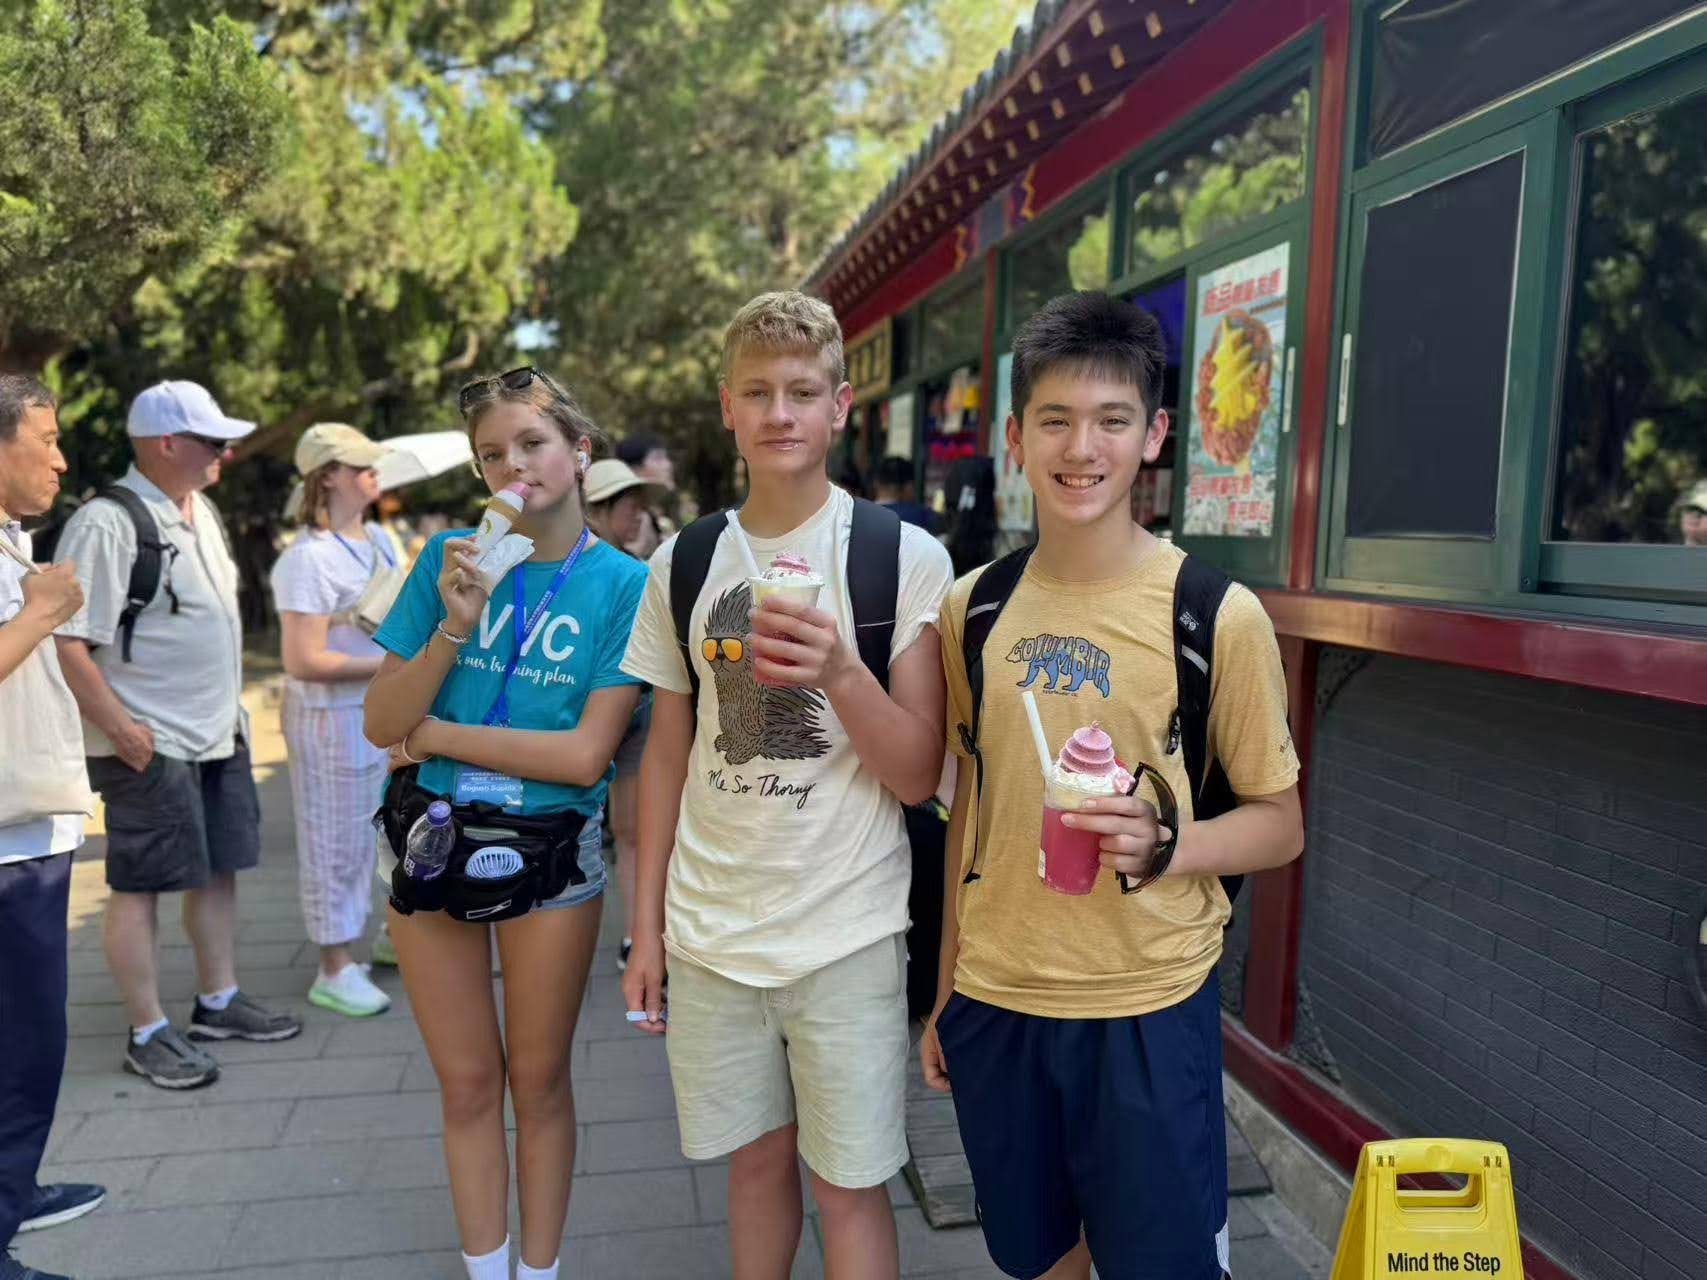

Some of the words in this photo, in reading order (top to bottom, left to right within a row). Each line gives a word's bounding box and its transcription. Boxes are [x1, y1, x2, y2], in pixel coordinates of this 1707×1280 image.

[464, 656, 486, 670] our
[490, 655, 542, 684] trning
[543, 665, 576, 687] plan
[1005, 633, 1111, 698] COLUMBIA
[708, 768, 727, 791] Me
[732, 774, 752, 793] So
[757, 773, 817, 809] Thorny
[1387, 1252, 1429, 1272] Mind
[1433, 1251, 1459, 1271] the
[1463, 1251, 1500, 1276] Step
